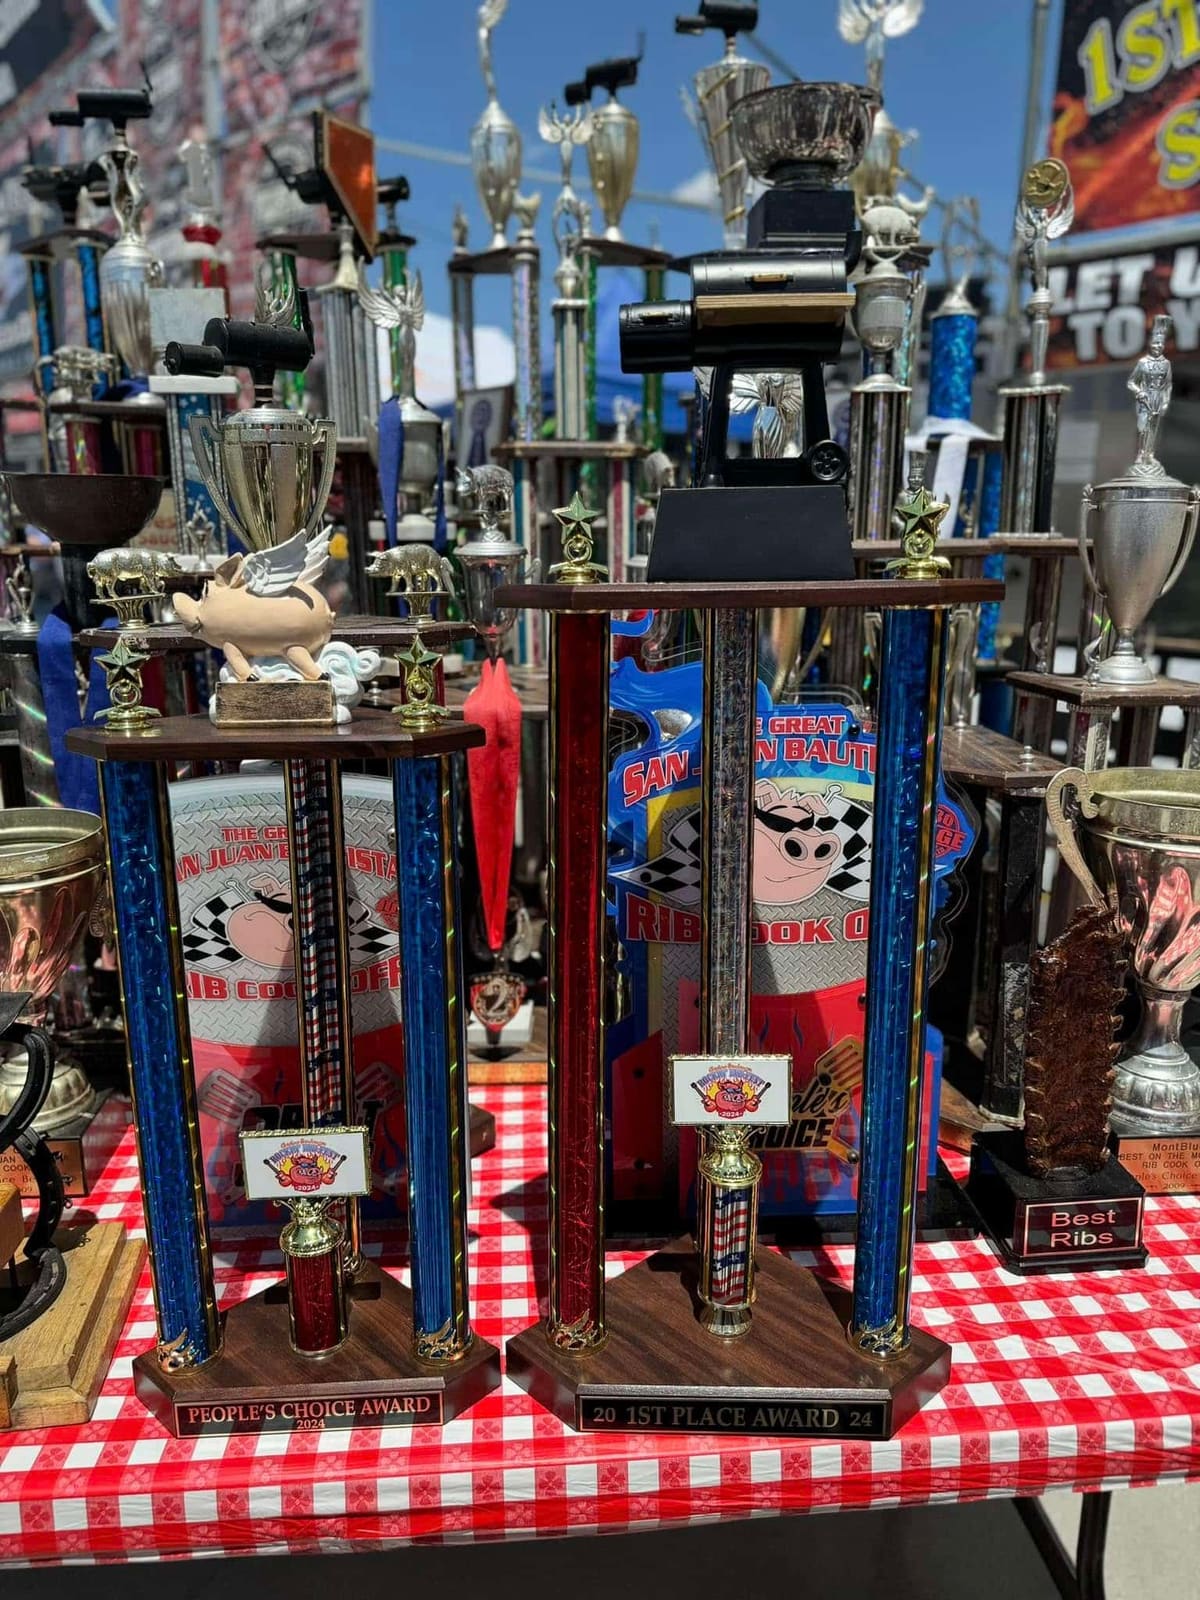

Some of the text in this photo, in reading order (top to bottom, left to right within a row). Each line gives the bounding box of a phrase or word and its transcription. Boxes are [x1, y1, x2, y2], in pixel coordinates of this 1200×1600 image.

[1077, 0, 1200, 116] 1ST
[1047, 252, 1156, 316] LET
[1067, 304, 1146, 362] TO
[768, 715, 847, 736] GREAT
[783, 737, 877, 774] BAUTI
[624, 750, 689, 808] SAN
[222, 826, 259, 843] THE
[205, 842, 273, 873] JUAN
[187, 969, 230, 1001] IB
[1119, 1152, 1144, 1161] BEST
[1148, 1152, 1162, 1161] ON
[1167, 1151, 1185, 1160] THE
[1163, 1160, 1188, 1169] COOK
[1051, 1209, 1116, 1228] Best
[1050, 1230, 1114, 1248] Ribs
[188, 1396, 431, 1424] PEOPLE'S CHOICE AWARD
[593, 1405, 873, 1429] 20 1ST PLACE AWARD 24
[296, 1418, 326, 1430] 2024
